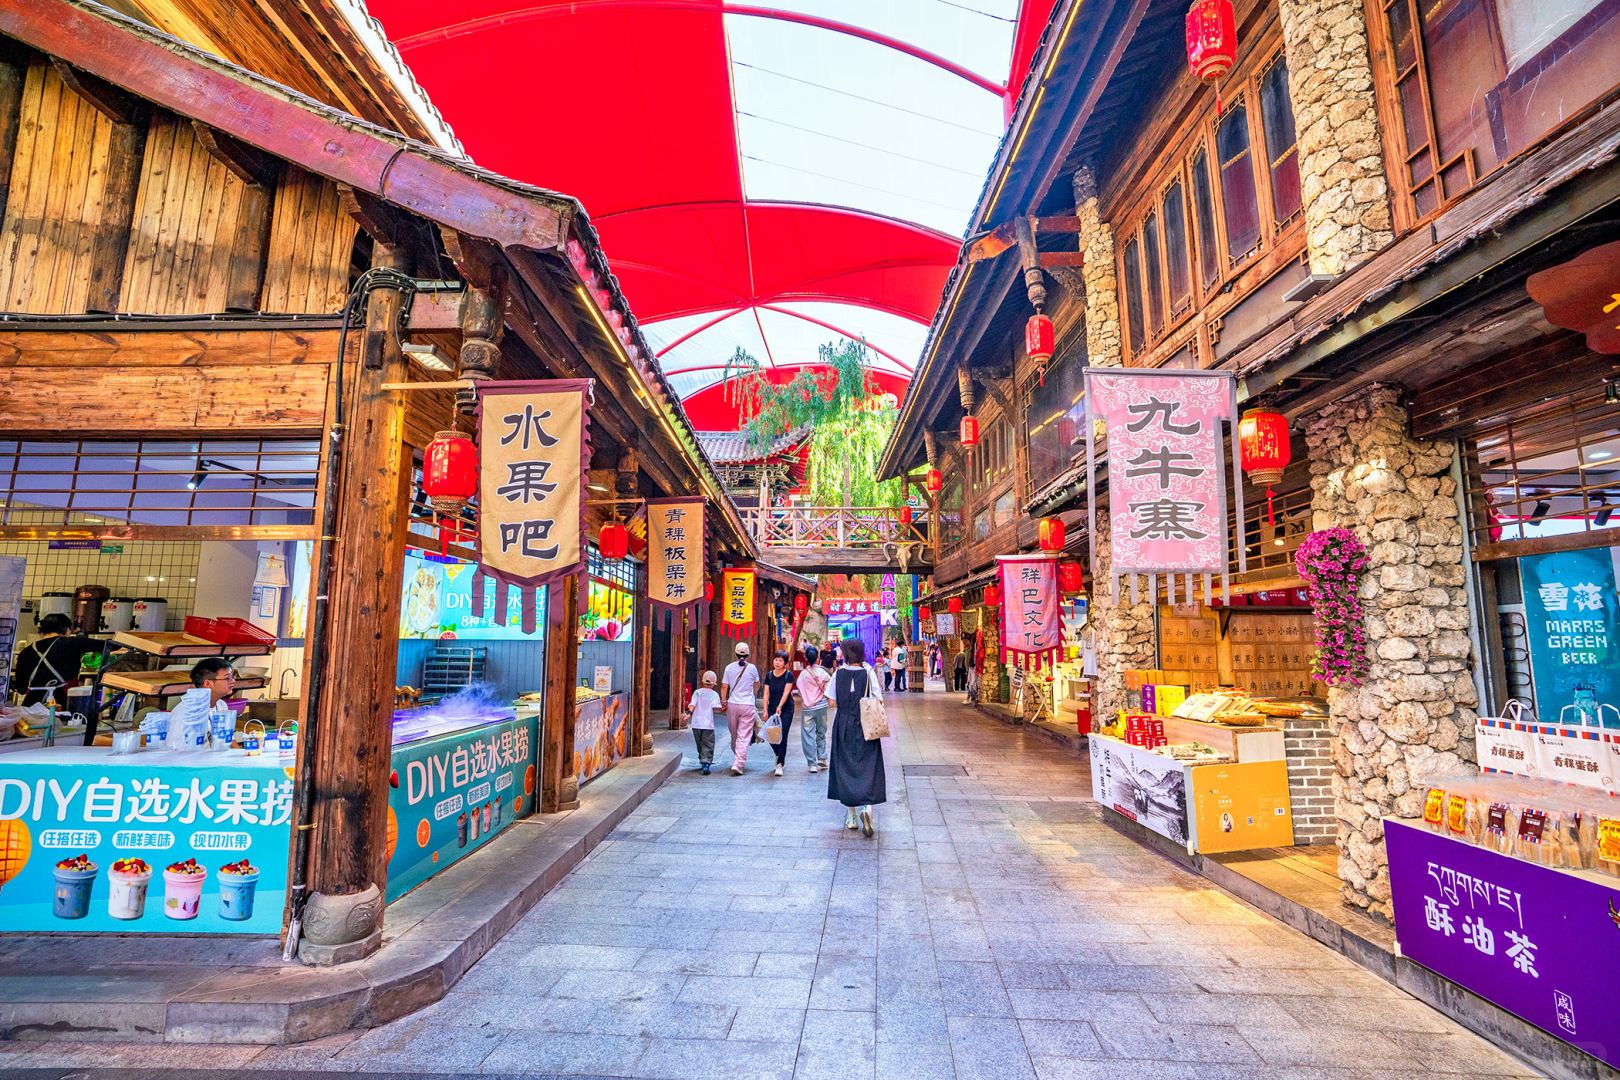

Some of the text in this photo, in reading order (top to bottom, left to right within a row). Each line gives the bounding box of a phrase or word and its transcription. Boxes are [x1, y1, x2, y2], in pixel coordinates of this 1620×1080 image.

[497, 403, 560, 560] 水果吧
[1125, 396, 1209, 541] 九牛寨
[664, 508, 688, 599] 青稞板栗饼
[730, 579, 746, 621] 一品茶社
[1021, 567, 1044, 648] 祥巴文化
[1538, 582, 1604, 612] 雪花
[1546, 620, 1606, 633] MARRS
[1548, 635, 1608, 648] GREEN
[1562, 653, 1597, 664] BEER
[406, 727, 529, 806] DIY自选水果捞
[1553, 756, 1600, 773] 青稞蛋酥
[0, 776, 293, 827] DIY自选水果捞
[42, 831, 98, 848] 任搭任选
[115, 832, 172, 848] 新鲜美味
[193, 833, 249, 849] 现切水果
[1424, 895, 1539, 978] 酥油茶
[1557, 995, 1576, 1028] 咸味
